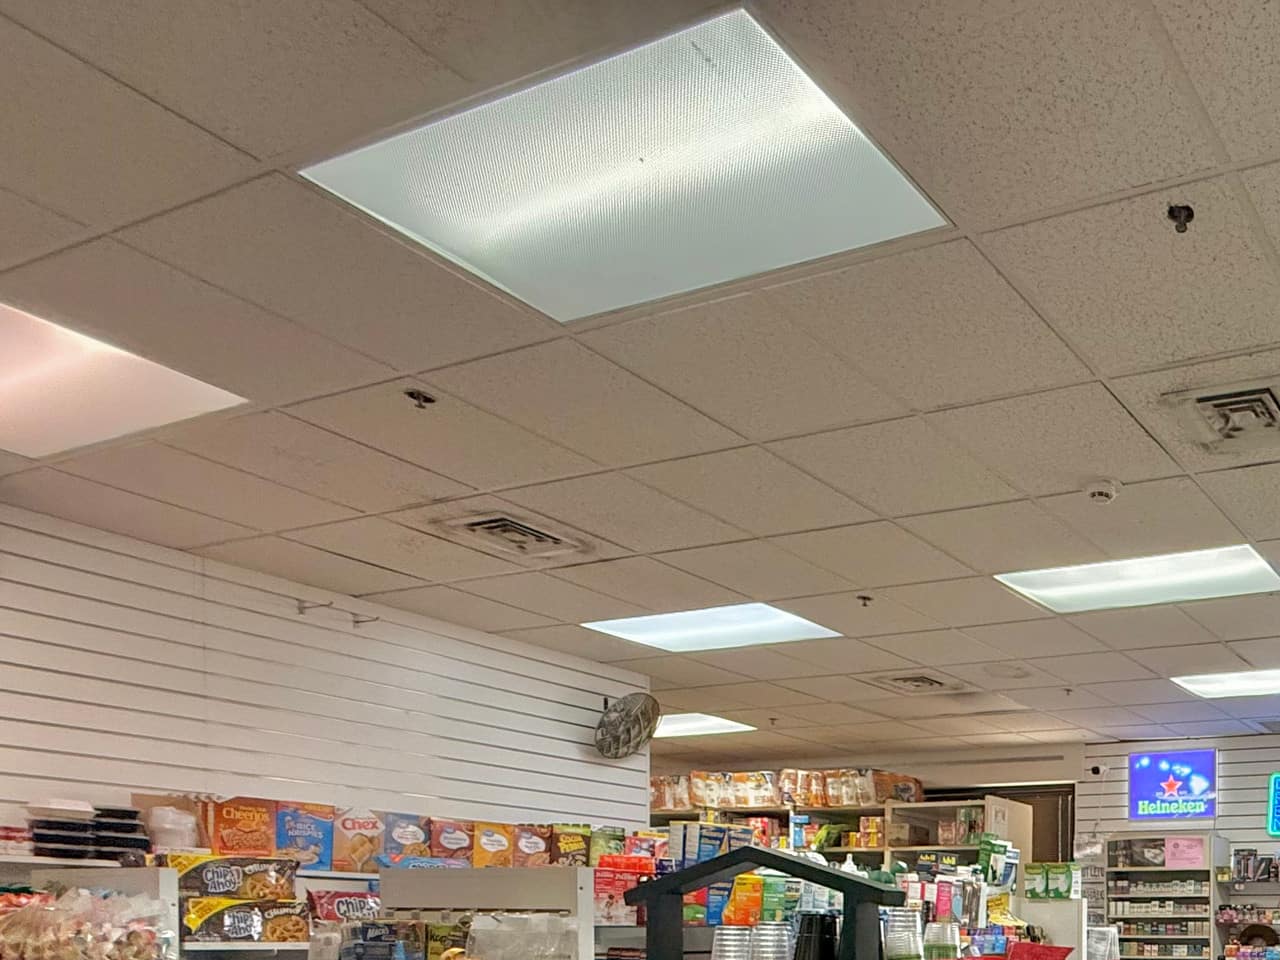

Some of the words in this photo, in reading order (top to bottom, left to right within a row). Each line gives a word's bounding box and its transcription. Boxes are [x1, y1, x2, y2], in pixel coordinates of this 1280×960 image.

[223, 806, 270, 822] Cheerios
[1137, 799, 1206, 815] Heineken
[342, 818, 379, 831] Chex
